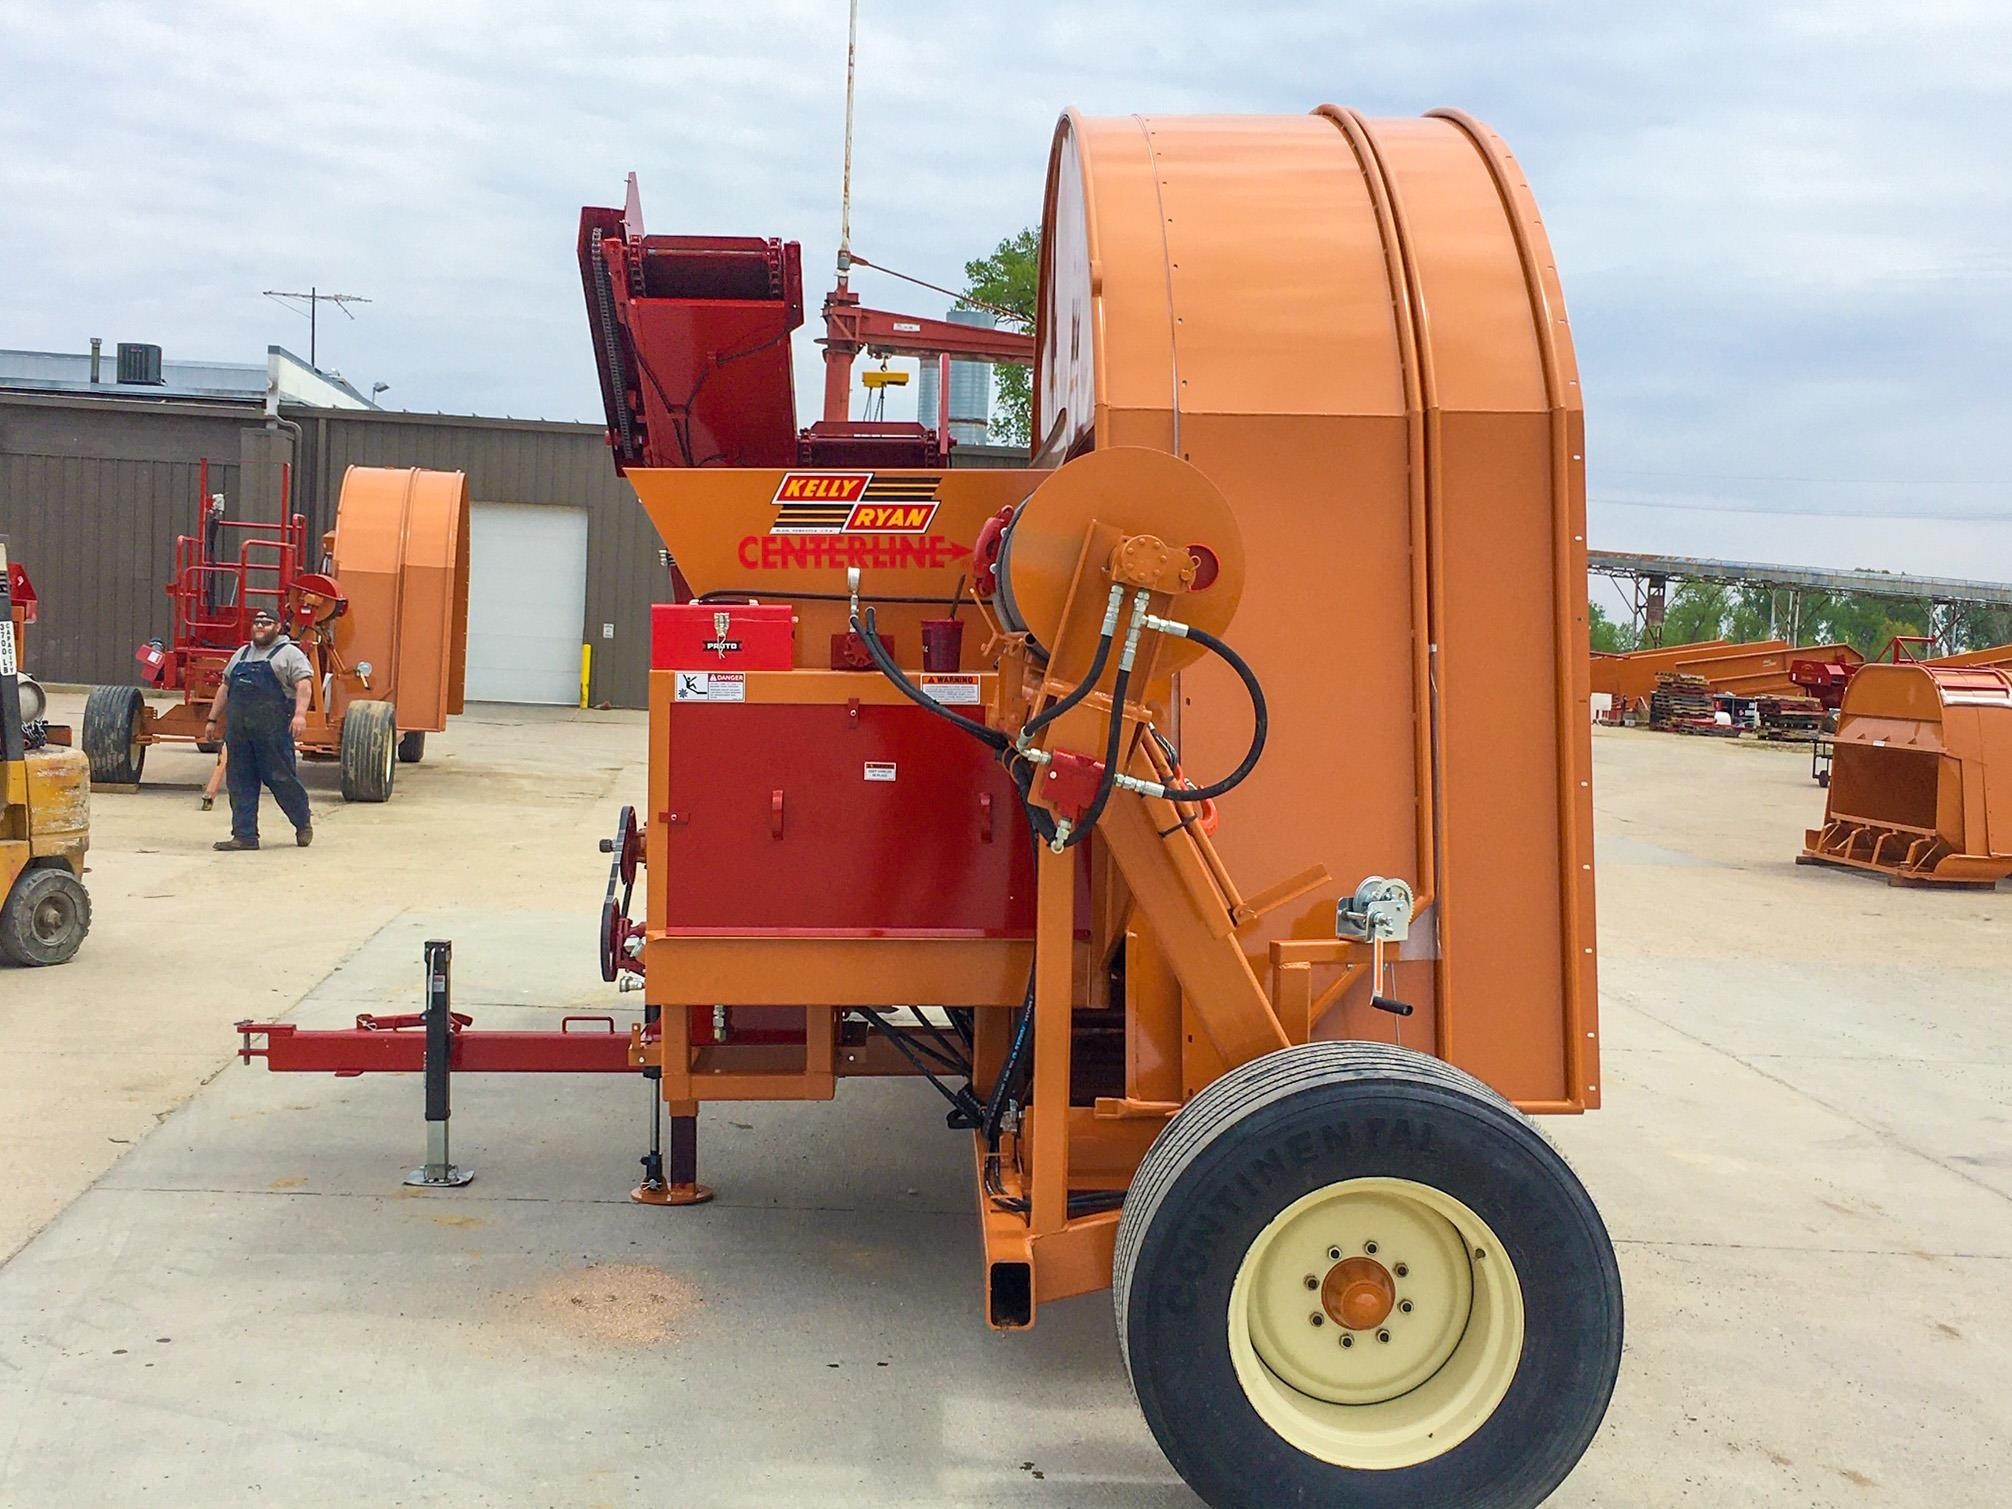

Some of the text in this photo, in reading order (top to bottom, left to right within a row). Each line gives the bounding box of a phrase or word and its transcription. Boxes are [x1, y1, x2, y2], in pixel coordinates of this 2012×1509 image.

[784, 479, 859, 497] KELLY
[854, 508, 928, 527] RYAN
[738, 536, 945, 570] CENTERLINE
[6, 623, 14, 673] CAPACITY
[706, 642, 738, 650] PROTO
[716, 674, 744, 682] DANGER
[937, 675, 974, 684] WARNING
